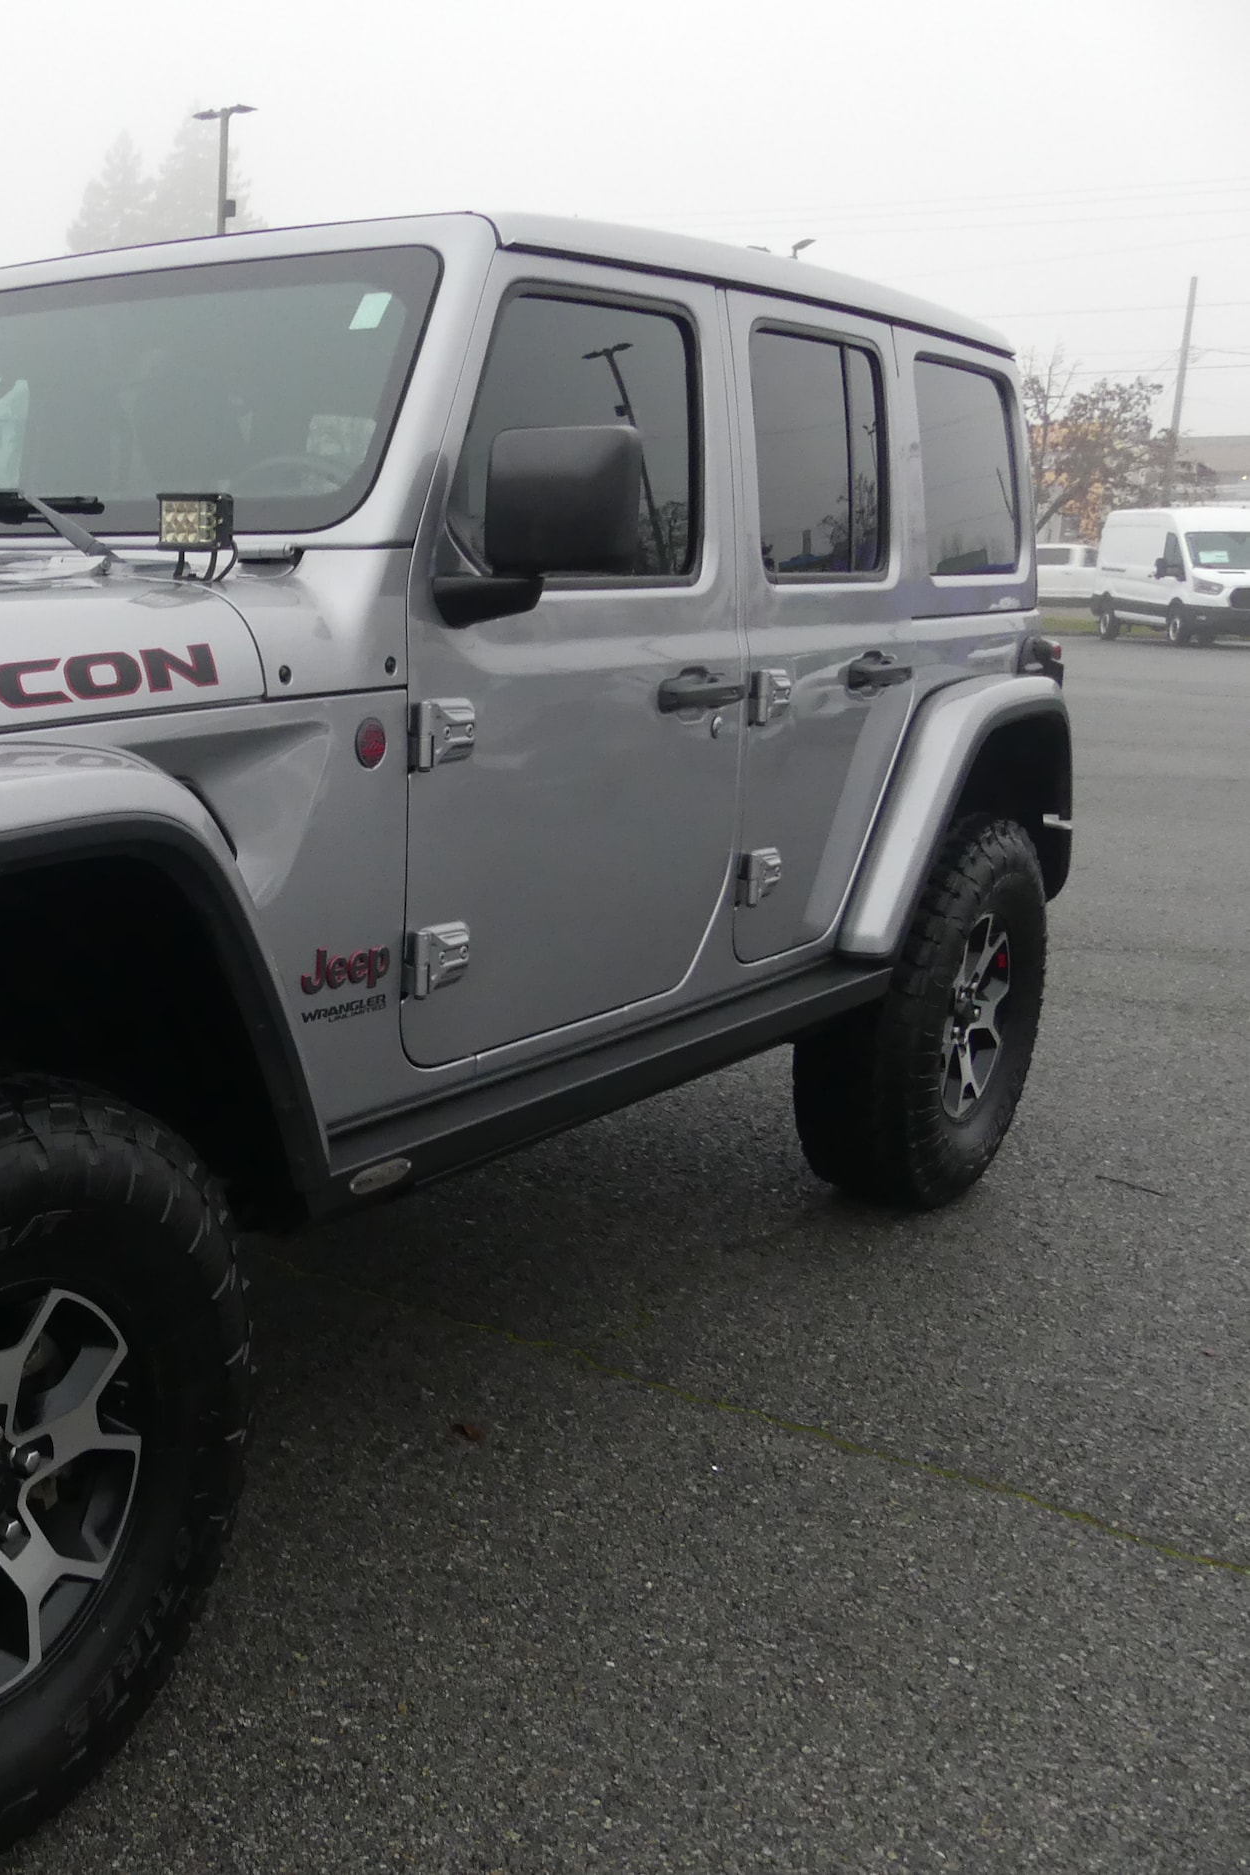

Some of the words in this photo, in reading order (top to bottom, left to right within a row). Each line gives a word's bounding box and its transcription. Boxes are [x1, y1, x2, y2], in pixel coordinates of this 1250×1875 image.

[301, 944, 390, 995] Jeep
[301, 993, 386, 1023] WRANGLER
[328, 1003, 386, 1023] UNLIMITED
